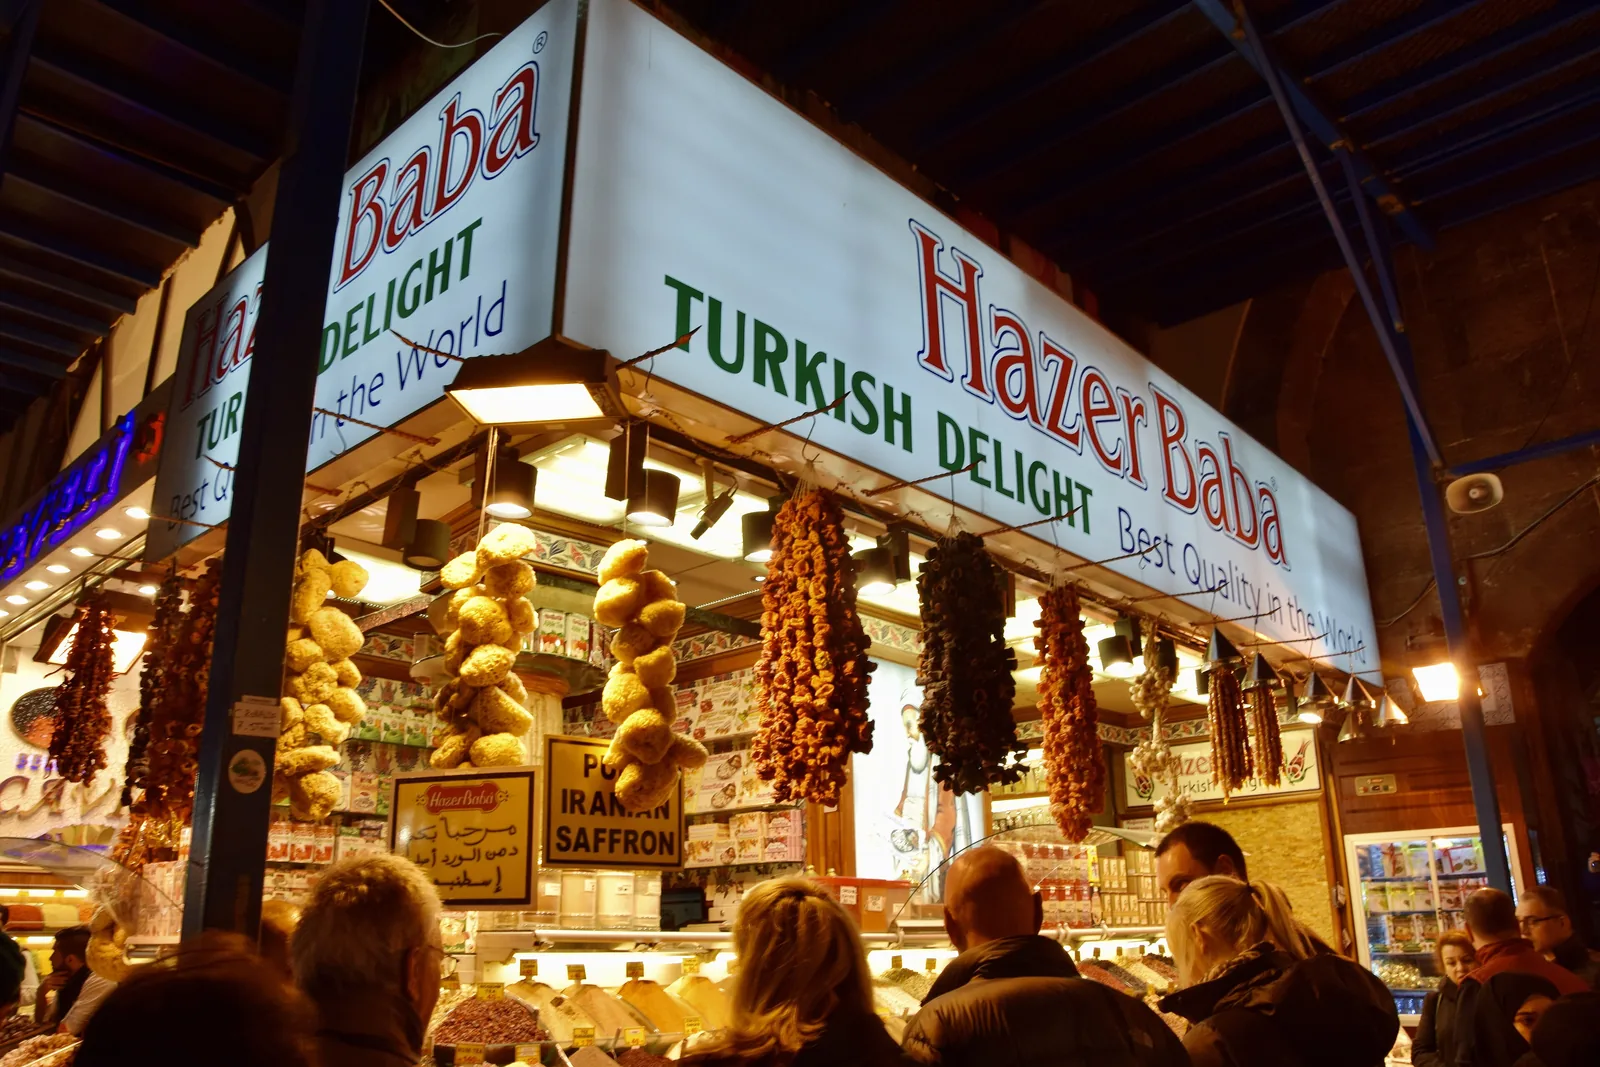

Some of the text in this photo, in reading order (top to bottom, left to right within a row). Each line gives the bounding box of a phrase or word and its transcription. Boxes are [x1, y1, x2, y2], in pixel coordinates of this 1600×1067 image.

[333, 60, 540, 293] Baba
[318, 218, 482, 375] DELIGHT
[168, 477, 209, 532] Best
[310, 408, 327, 445] n
[336, 372, 384, 427] the
[397, 280, 507, 391] World
[664, 274, 1093, 535] TURKISH DELIGHT
[908, 218, 1291, 571] Hazer Baba
[1118, 506, 1366, 664] Best Quality in the World
[555, 825, 675, 856] SAFFRON
[561, 788, 670, 820] IRANN
